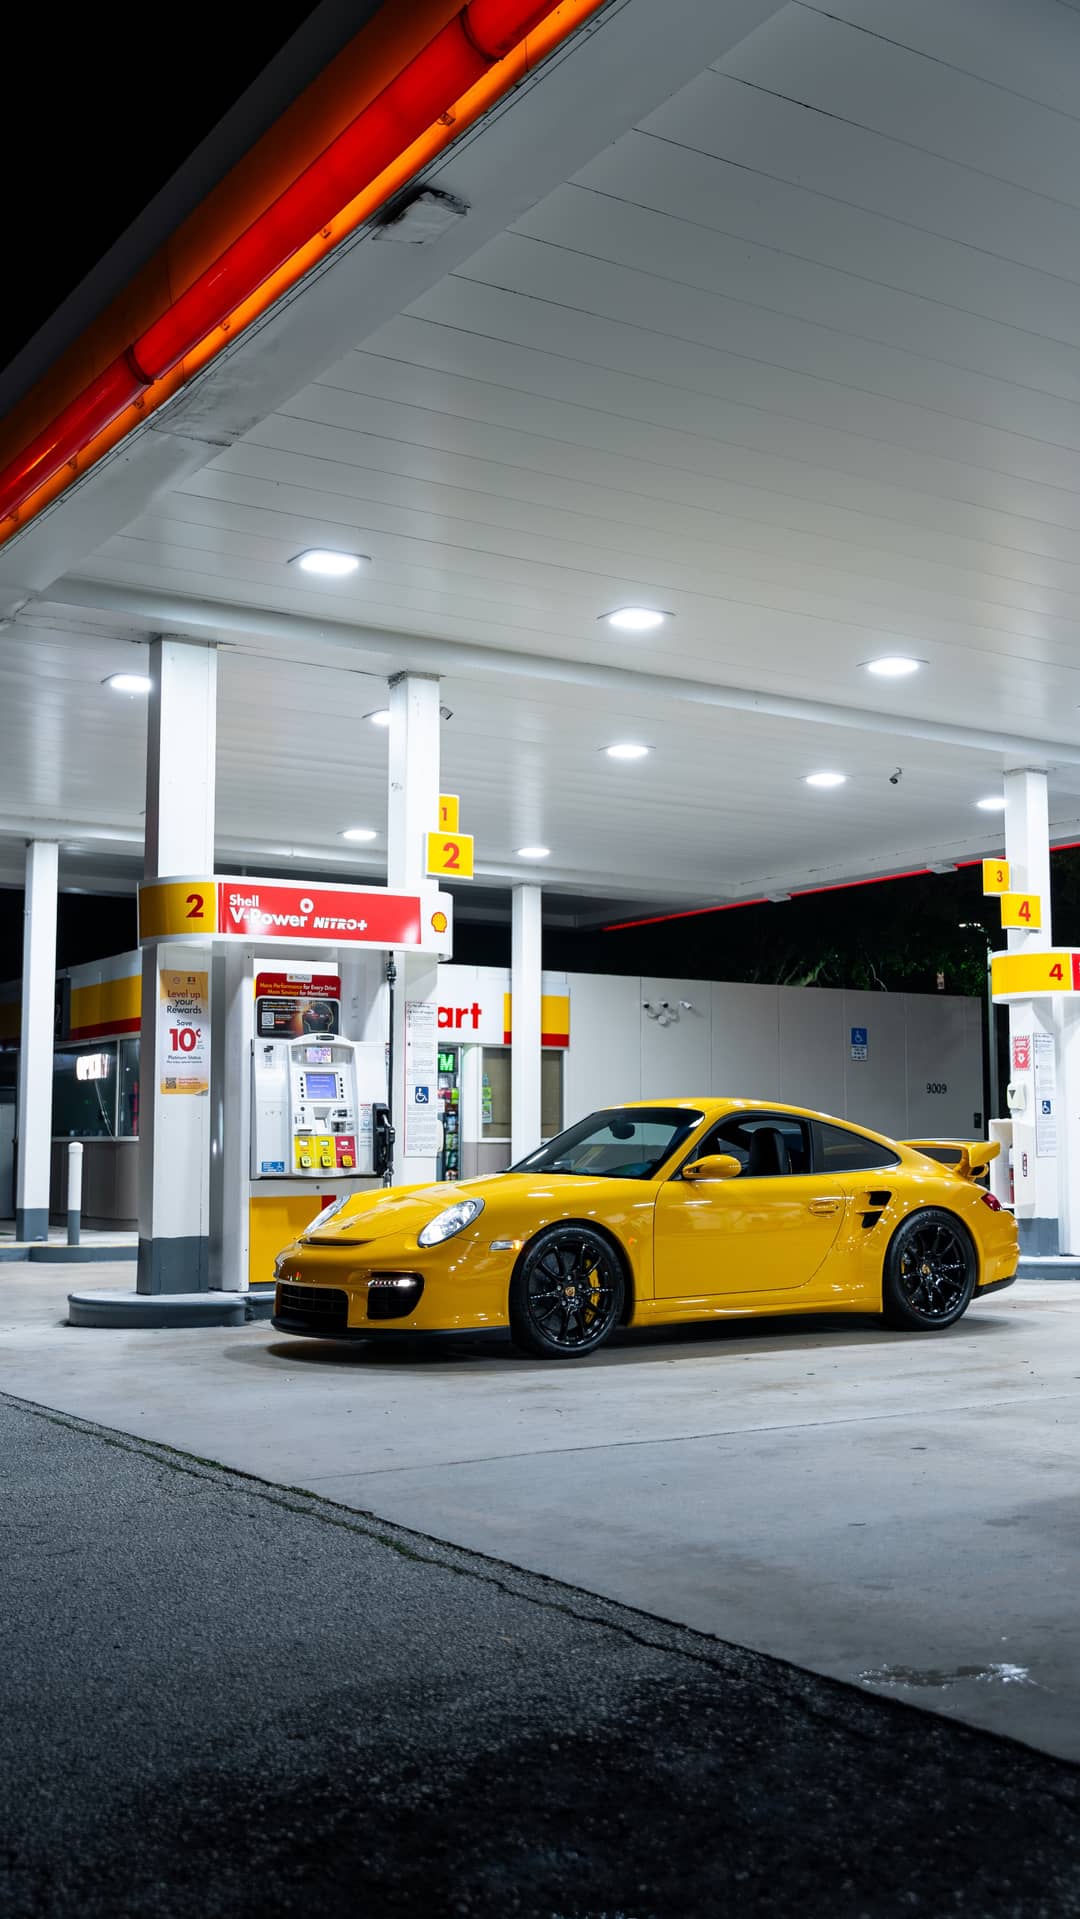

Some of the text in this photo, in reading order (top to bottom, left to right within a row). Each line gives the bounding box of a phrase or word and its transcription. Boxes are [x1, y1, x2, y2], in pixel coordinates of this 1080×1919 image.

[442, 807, 448, 821] 1
[443, 842, 460, 870] 2
[996, 870, 1003, 882] 3
[186, 894, 204, 919] 2
[229, 894, 259, 907] Shell
[229, 907, 308, 927] V-Power
[1018, 901, 1031, 922] 4
[1049, 963, 1063, 981] 4
[167, 988, 200, 1000] Level up
[167, 1005, 202, 1014] Rewards
[175, 999, 193, 1007] your
[438, 1003, 482, 1029] art
[438, 1053, 454, 1071] M
[926, 1083, 947, 1094] 9009
